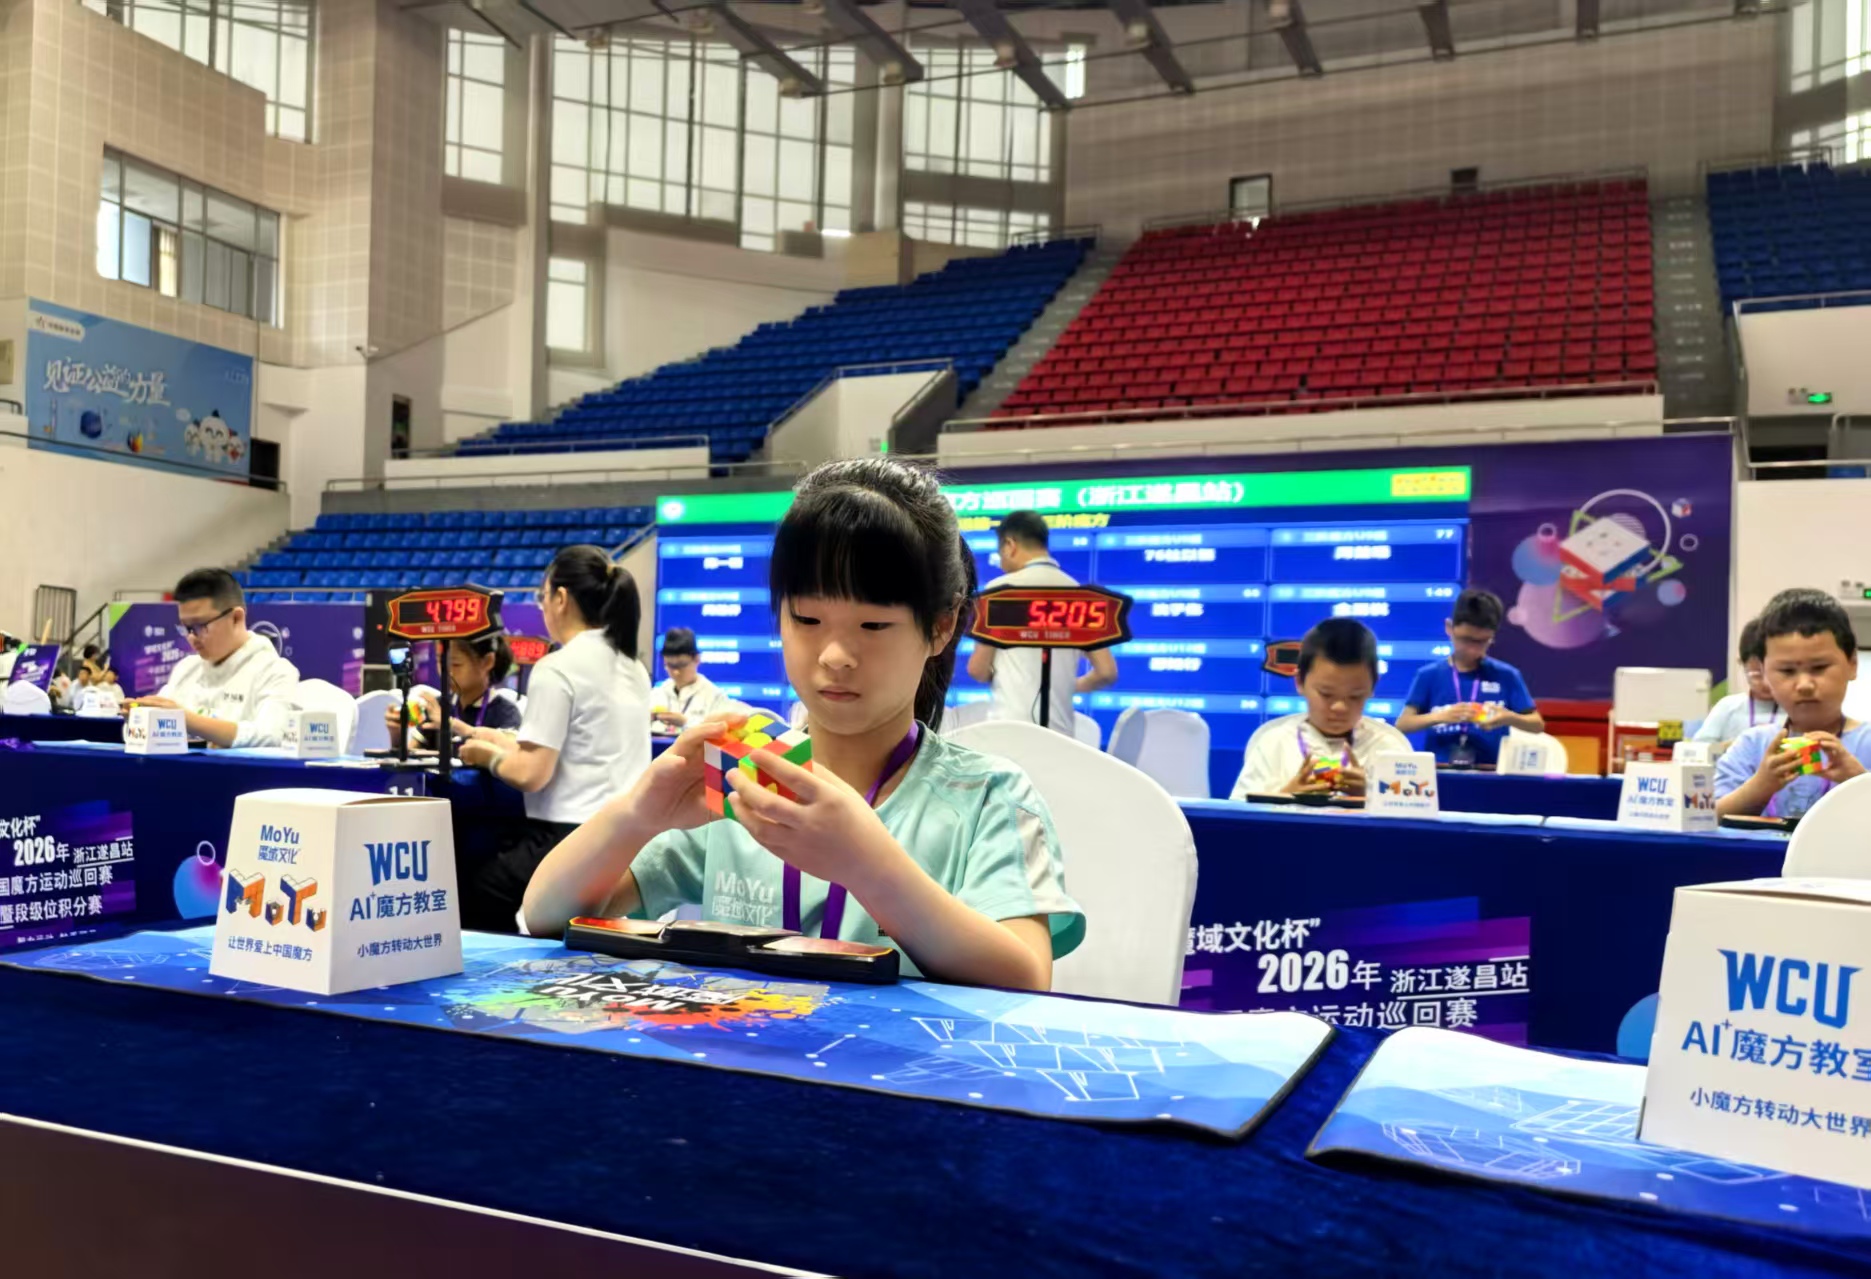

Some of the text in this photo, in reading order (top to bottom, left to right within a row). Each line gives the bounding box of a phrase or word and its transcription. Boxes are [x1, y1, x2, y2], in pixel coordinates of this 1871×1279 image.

[43, 356, 171, 407] 见证公益的力量
[157, 718, 177, 730] WCU
[309, 723, 330, 733] WCU
[1378, 780, 1435, 797] MoYu
[1637, 776, 1668, 794] WCU
[259, 824, 300, 845] MoYu
[13, 835, 134, 867] 2026年 浙江遂昌站
[257, 845, 300, 865] 魔域文化
[363, 840, 432, 886] WCU
[225, 868, 327, 933] MoYu
[714, 871, 774, 903] MoYu
[711, 895, 773, 926] 魔域文化
[228, 936, 313, 961] 让世界爱上中国魔方
[357, 933, 442, 958] 小魔方转动大世界
[1257, 949, 1528, 993] 2026年 浙江遂昌站
[1717, 949, 1863, 1030] WCU
[1690, 1087, 1871, 1138] 小魔方转动大世界
